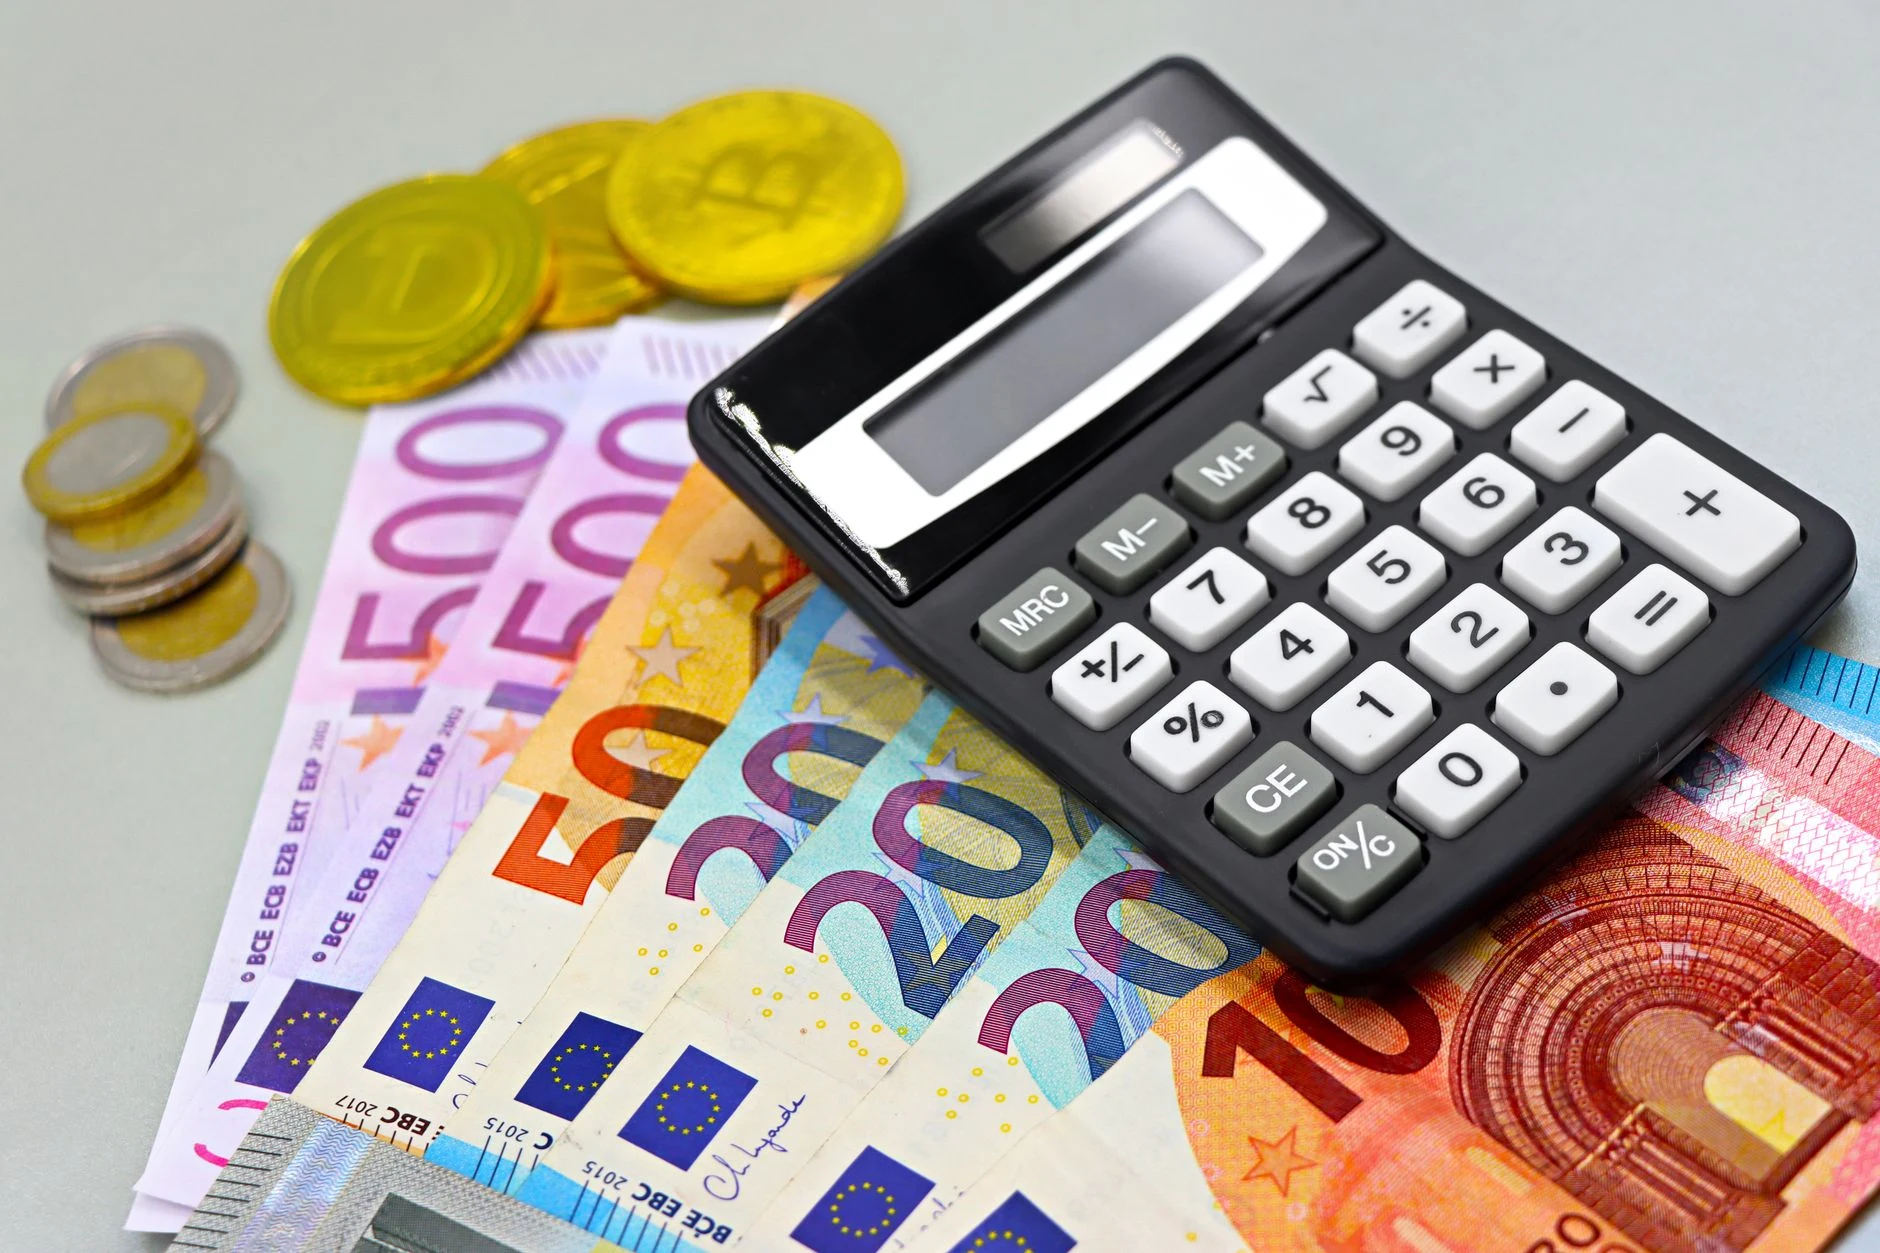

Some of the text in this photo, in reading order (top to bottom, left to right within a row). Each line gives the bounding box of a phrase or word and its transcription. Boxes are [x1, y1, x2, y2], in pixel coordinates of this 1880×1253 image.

[1380, 424, 1422, 456] 9
[1199, 443, 1256, 488] M+
[1462, 476, 1506, 509] 6
[1287, 496, 1331, 530] 8
[341, 404, 566, 660] 500
[1543, 530, 1590, 566] 3
[1366, 548, 1412, 584] 5
[1186, 568, 1226, 605] 7
[999, 584, 1070, 637] MRC
[1279, 628, 1315, 661] 4
[1450, 609, 1500, 649] 2
[1356, 690, 1395, 718] 1
[1163, 702, 1225, 743] %
[297, 757, 323, 793] EKP
[1437, 751, 1484, 788] 0
[491, 703, 728, 906] 50
[1245, 763, 1309, 814] CE
[286, 799, 312, 833] EKT
[272, 842, 298, 876] EZB
[321, 909, 356, 948] BCE
[346, 866, 379, 904] ECB
[370, 825, 402, 861] EZB
[394, 782, 425, 819] EKT
[416, 742, 446, 779] EKP
[1312, 820, 1396, 870] ON/C
[259, 884, 287, 920] ECB
[783, 779, 1054, 1020] 20
[246, 929, 274, 966] BCE
[1201, 972, 1442, 1123] 10
[335, 1095, 379, 1118] 2017
[380, 1106, 432, 1137] EBC
[483, 1116, 530, 1143] 2015
[582, 1160, 629, 1191] 2015
[631, 1182, 684, 1218] EBC
